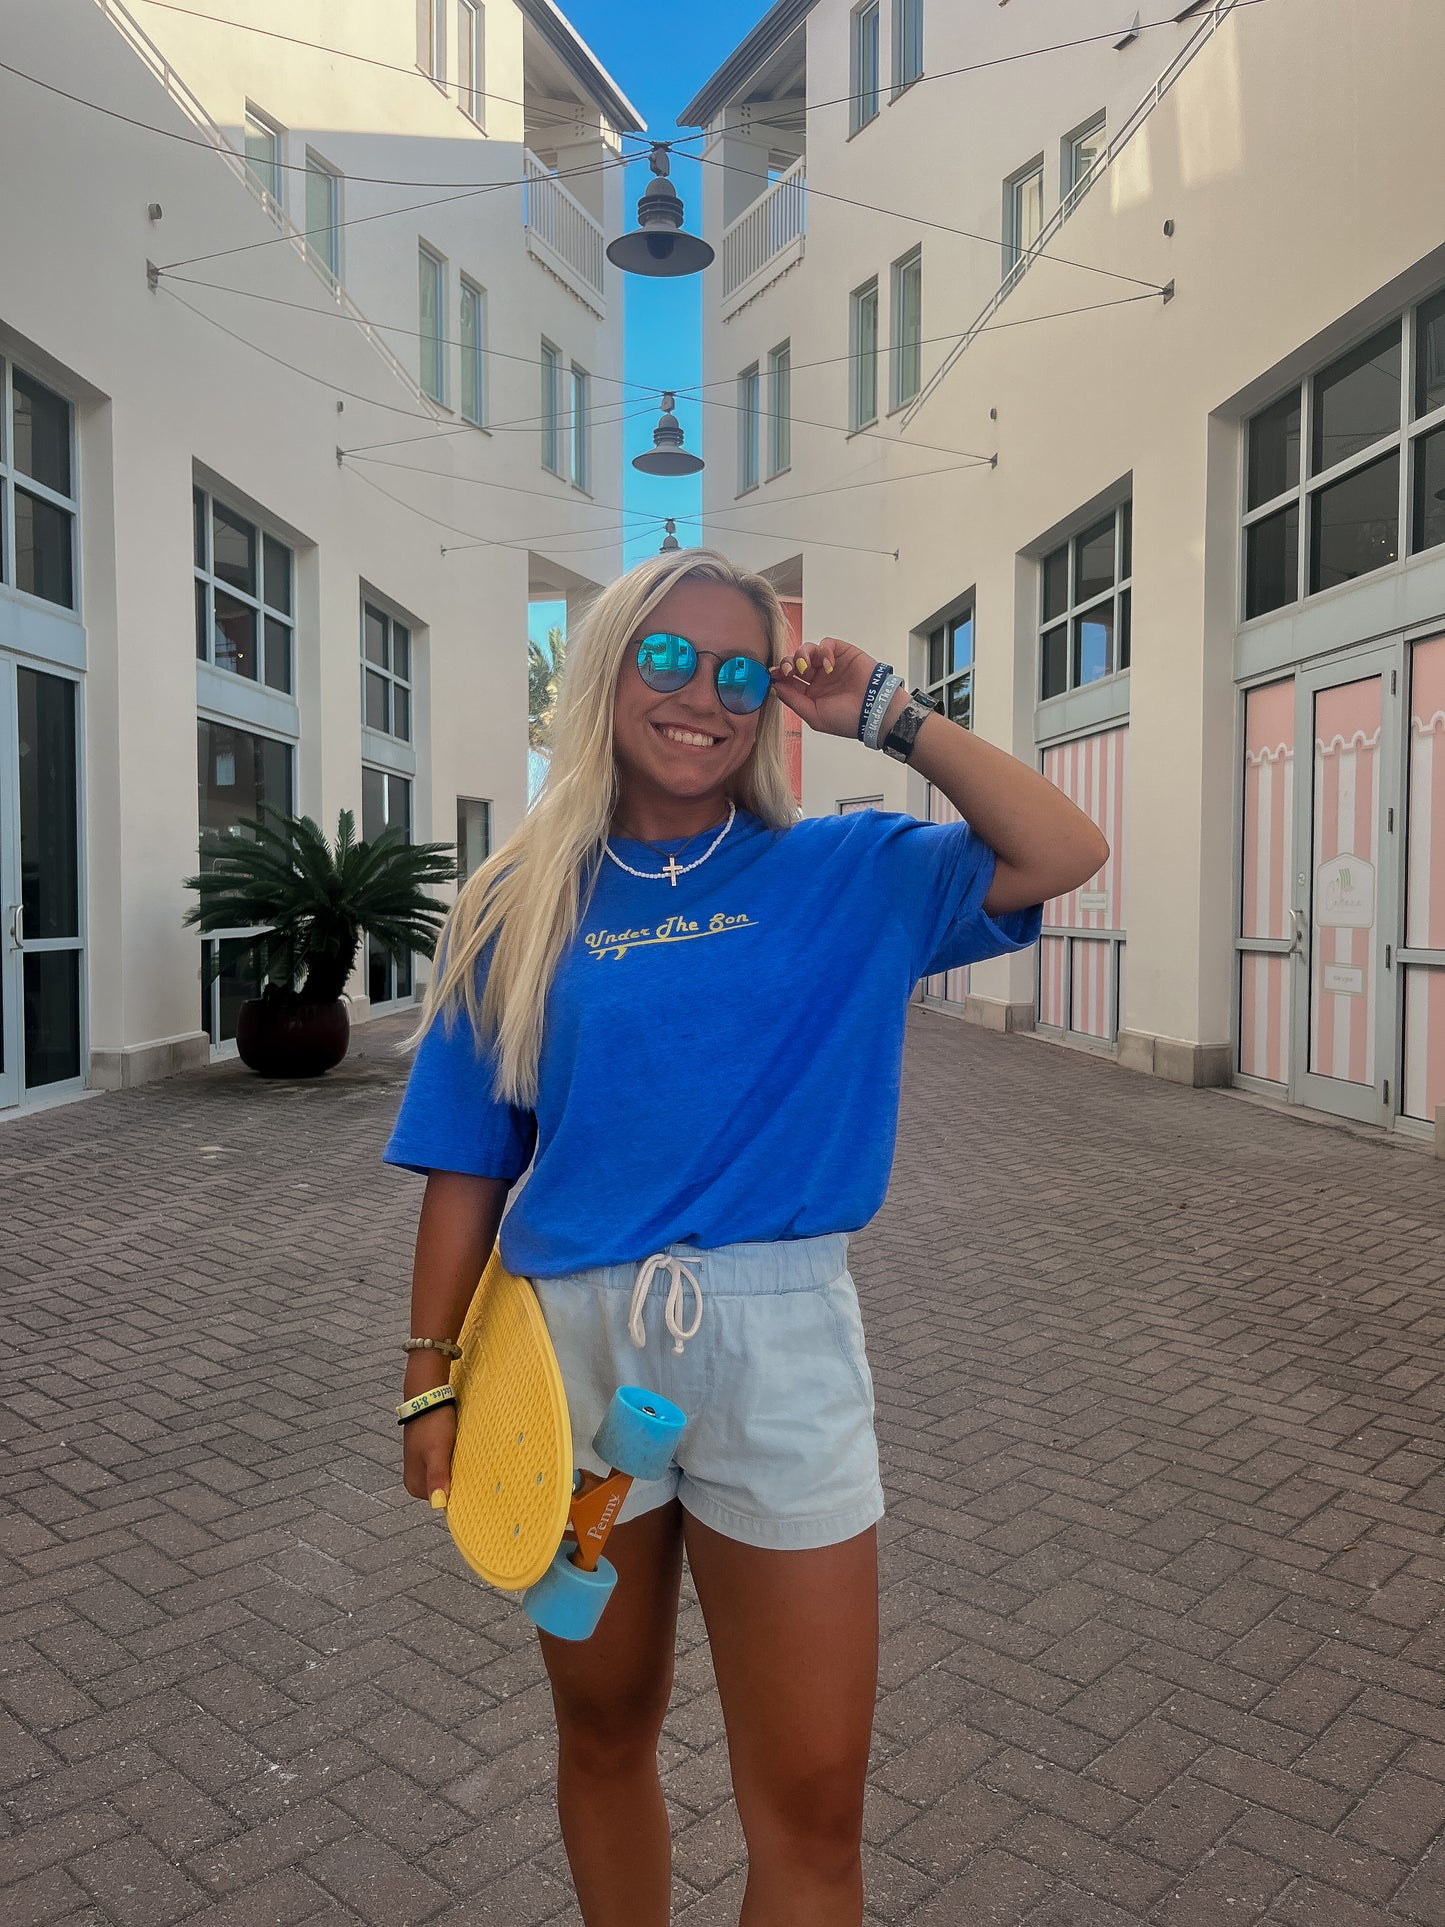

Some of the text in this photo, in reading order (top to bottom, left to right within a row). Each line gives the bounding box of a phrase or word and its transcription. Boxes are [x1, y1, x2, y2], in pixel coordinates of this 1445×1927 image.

[864, 689, 877, 719] JESUS
[872, 663, 888, 685] NAME
[868, 703, 884, 731] Under
[878, 688, 893, 703] The
[584, 912, 749, 948] Under The Son
[411, 1396, 429, 1412] 8:15
[587, 1494, 621, 1540] Penny
